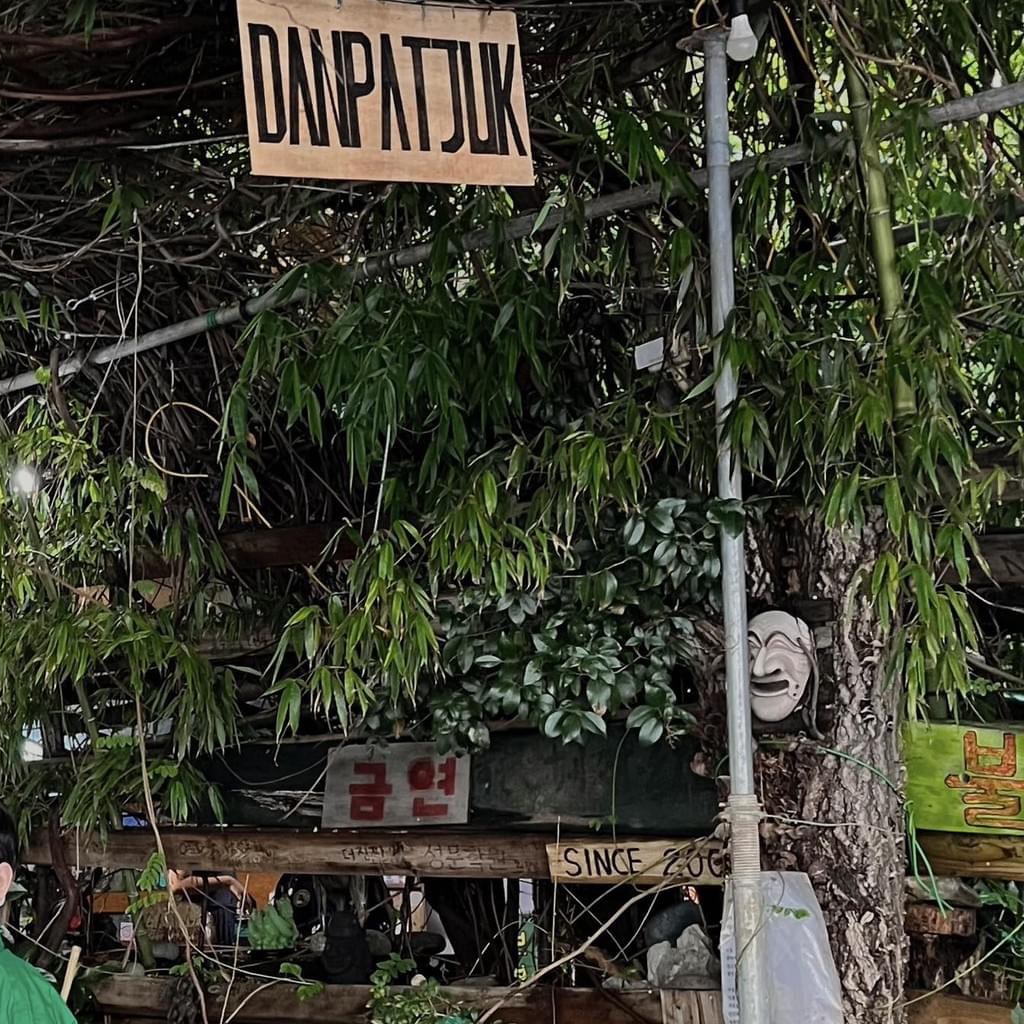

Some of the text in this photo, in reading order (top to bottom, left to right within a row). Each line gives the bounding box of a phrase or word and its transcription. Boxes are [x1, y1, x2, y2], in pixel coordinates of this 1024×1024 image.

[248, 23, 528, 156] DANPATJUK
[349, 756, 457, 821] 금연
[564, 847, 643, 877] SINCE
